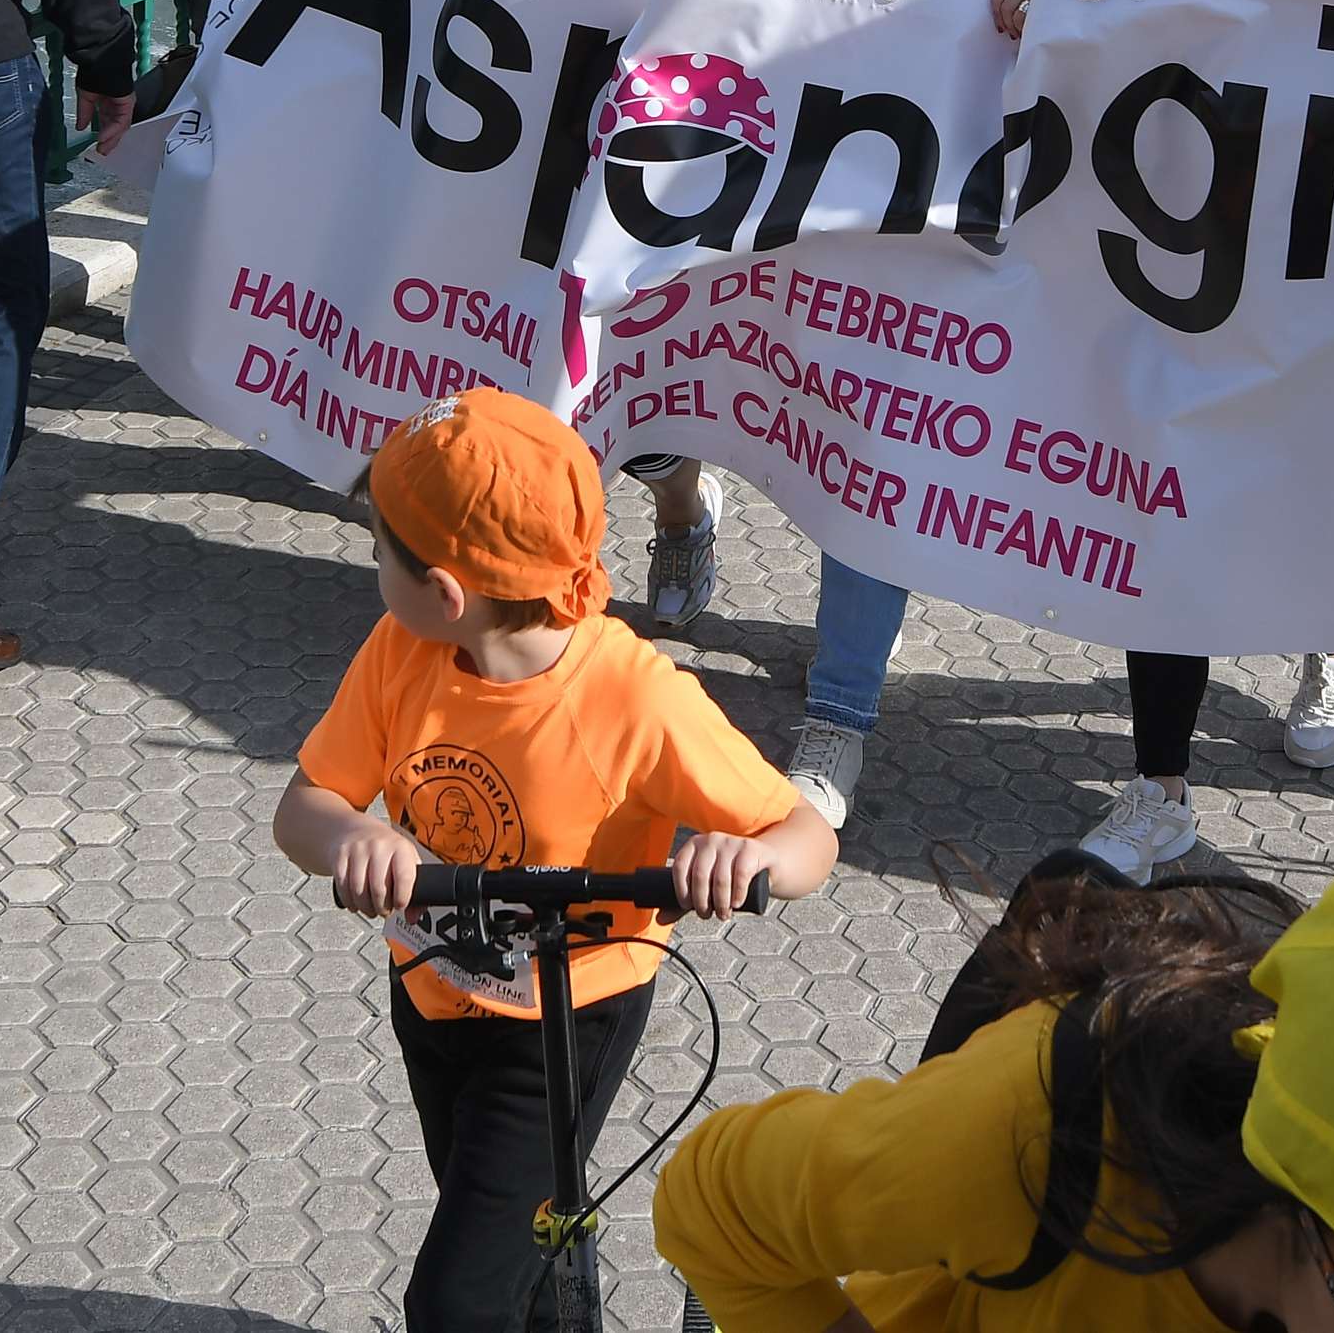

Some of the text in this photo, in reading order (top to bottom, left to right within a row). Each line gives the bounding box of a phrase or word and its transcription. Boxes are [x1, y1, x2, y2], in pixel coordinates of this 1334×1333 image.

[228, 267, 343, 358] HAUR
[665, 319, 992, 457] NAZIOARTEKO
[1004, 418, 1188, 519] EGUNA
[393, 278, 538, 369] OTSAIL
[709, 260, 777, 306] DE
[785, 268, 1012, 375] FEBRERO
[234, 343, 308, 421] DÍA
[627, 379, 719, 430] DEL
[732, 391, 908, 527] CÁNCER
[916, 483, 1144, 598] INFANTIL
[411, 755, 514, 836] MEMORIAL
